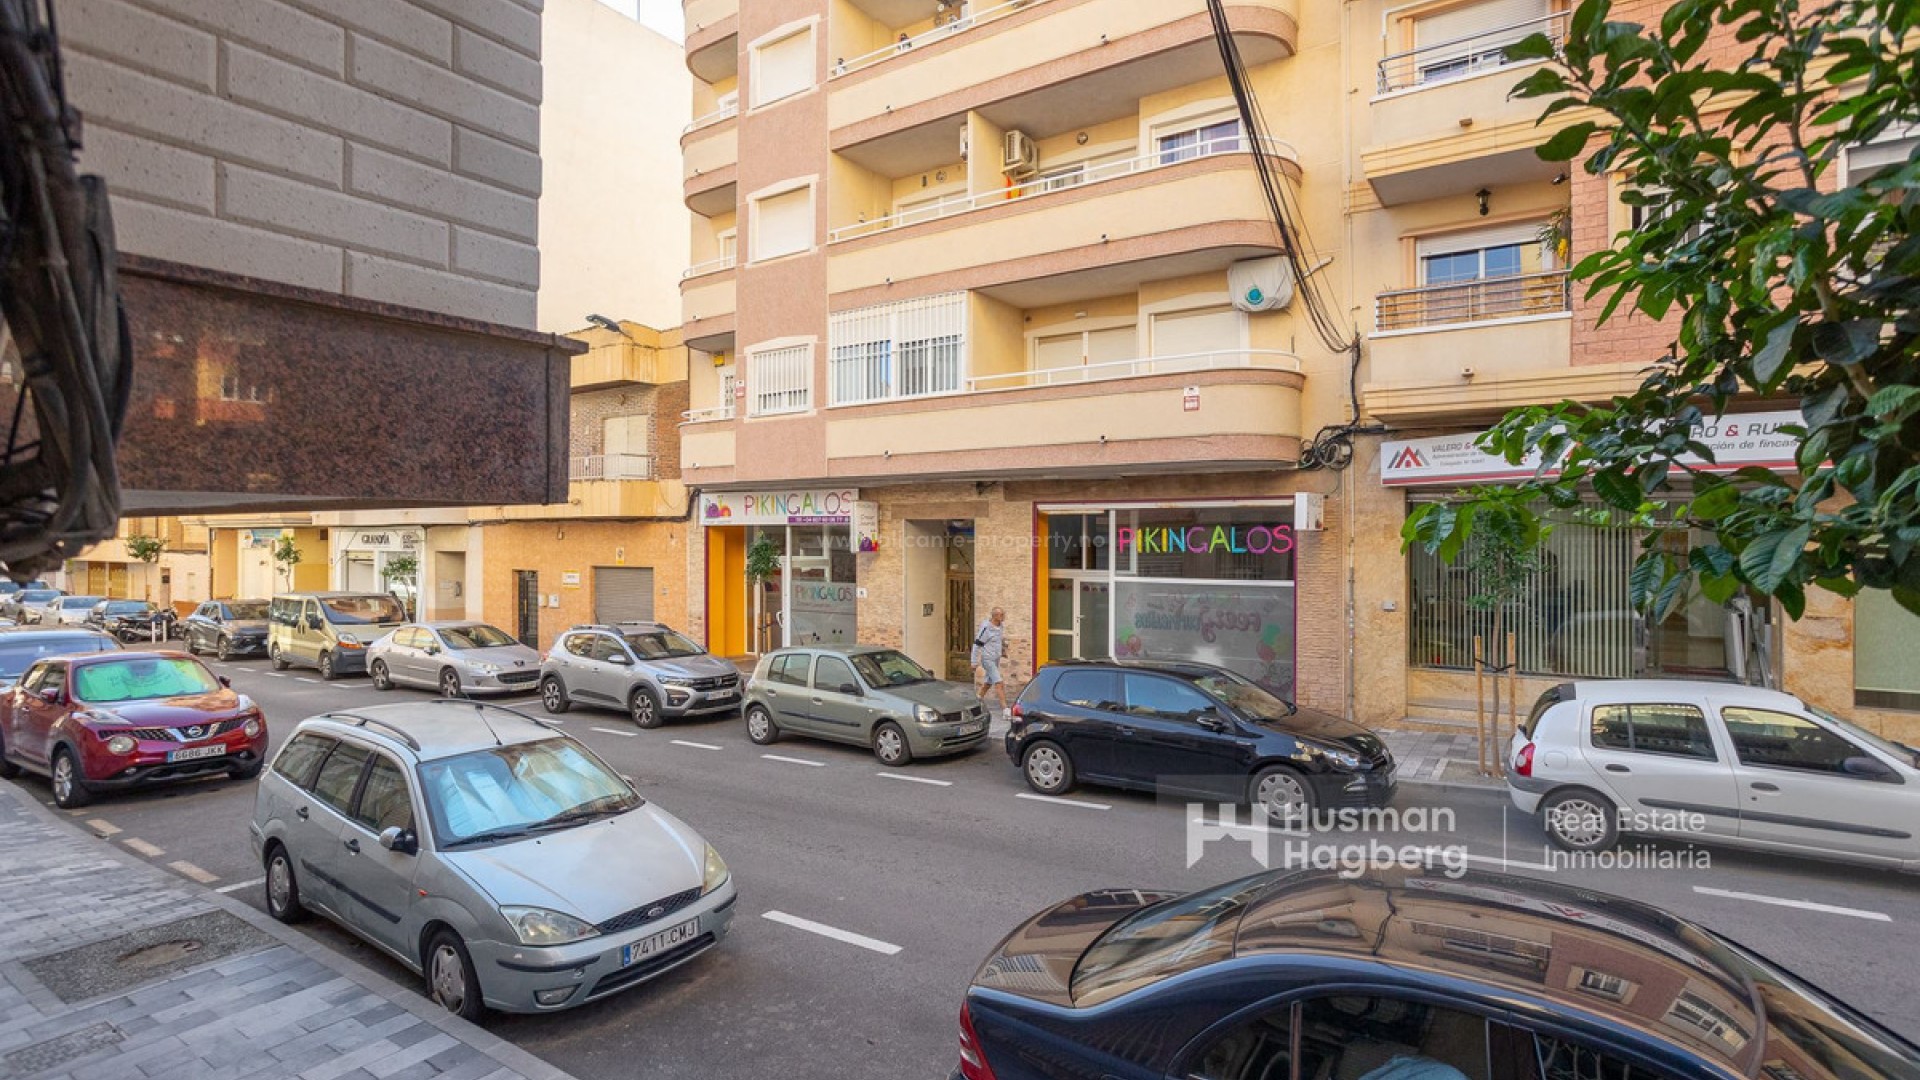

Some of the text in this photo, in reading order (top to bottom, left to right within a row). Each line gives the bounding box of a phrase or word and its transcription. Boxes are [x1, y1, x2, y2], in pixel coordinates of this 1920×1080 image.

[743, 491, 853, 516] PIKINGALOS
[1118, 524, 1293, 554] PIKINGALOS
[633, 922, 695, 959] 7411 CMJ
